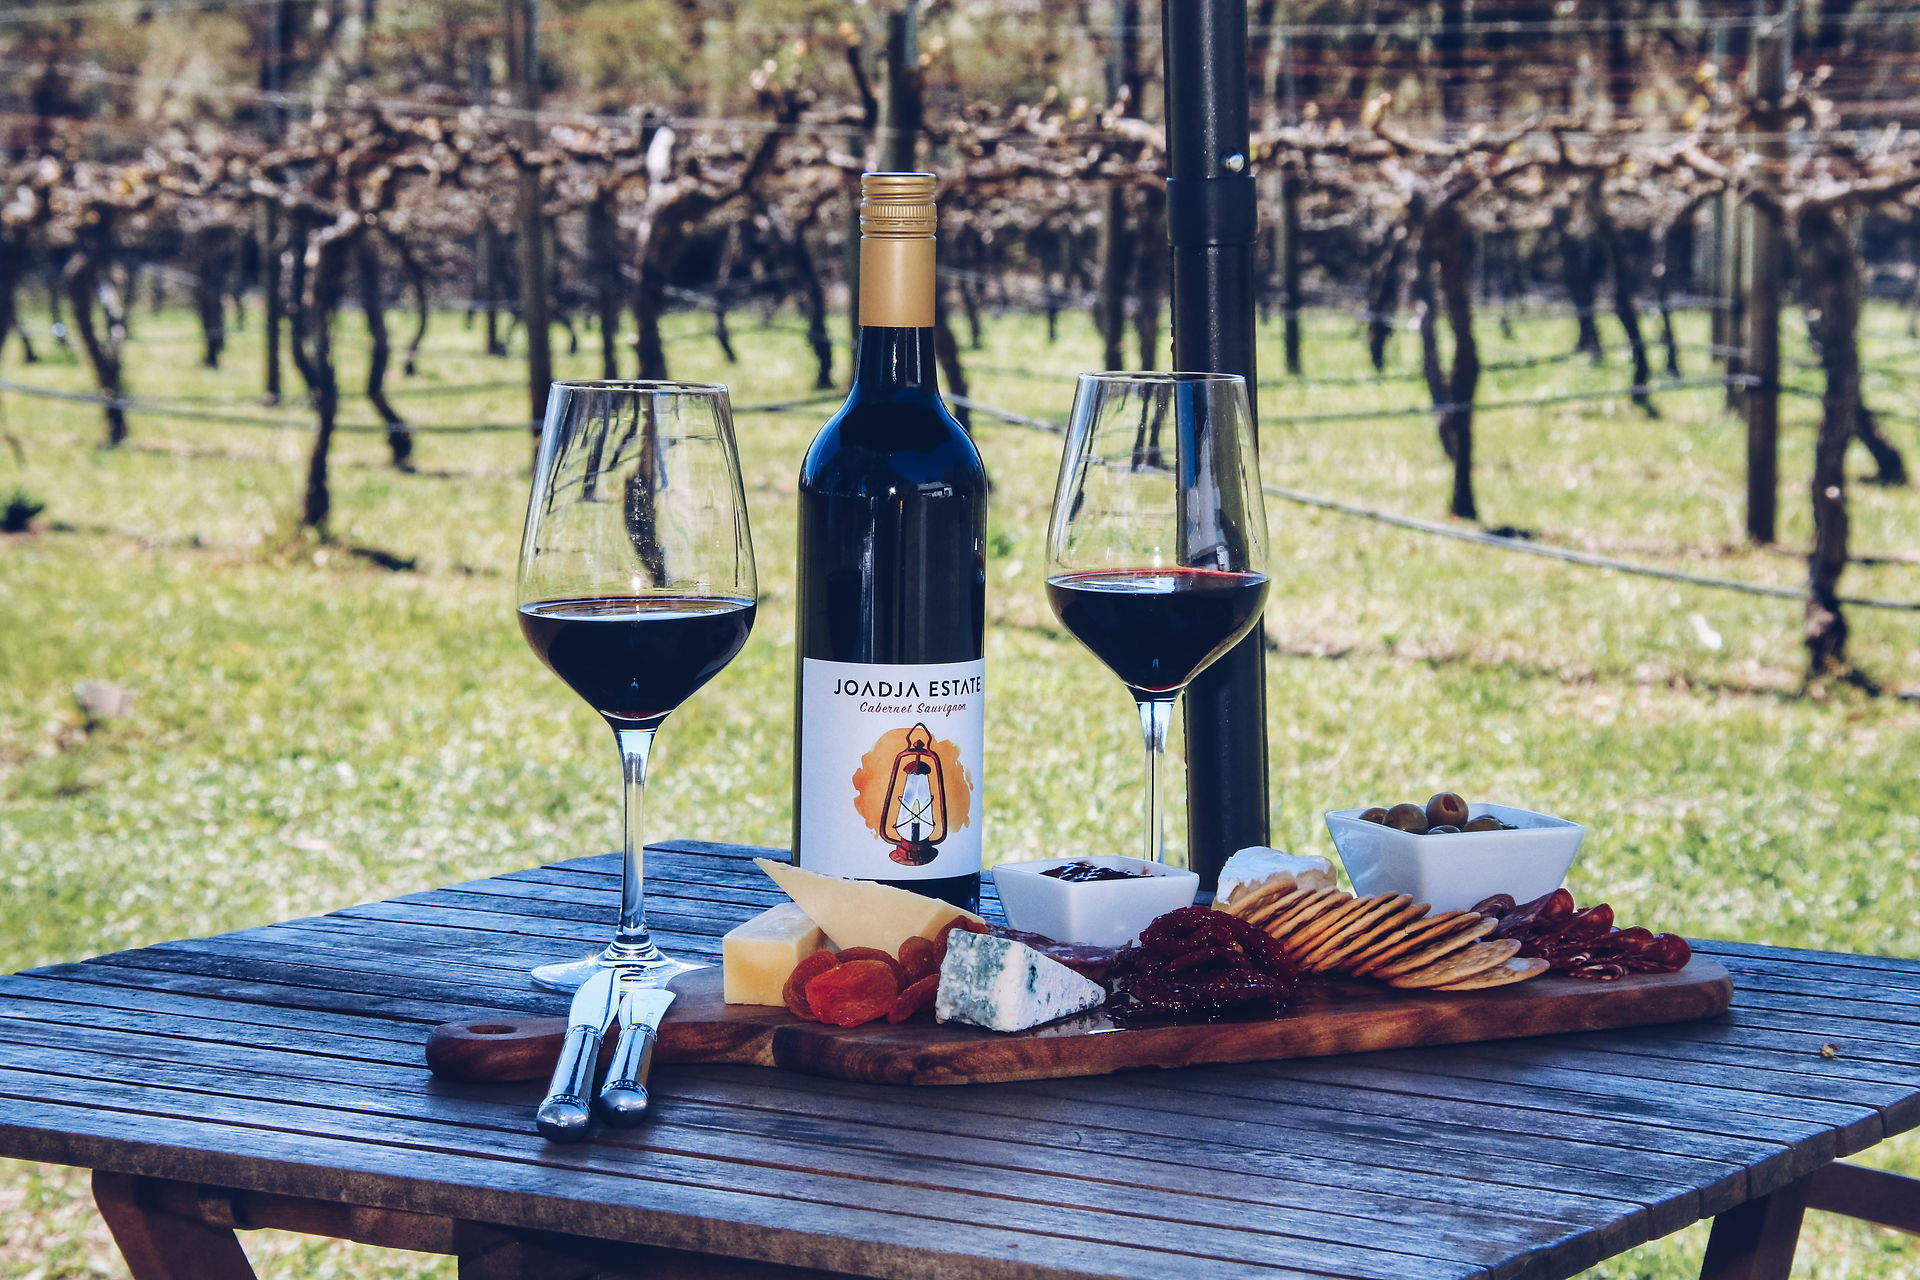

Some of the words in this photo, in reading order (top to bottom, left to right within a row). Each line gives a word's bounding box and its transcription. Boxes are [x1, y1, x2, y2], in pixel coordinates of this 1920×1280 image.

[834, 679, 920, 697] JOADJA
[929, 676, 981, 696] ESTATE
[860, 702, 912, 714] Cabernet
[916, 702, 967, 717] Sauvignon
